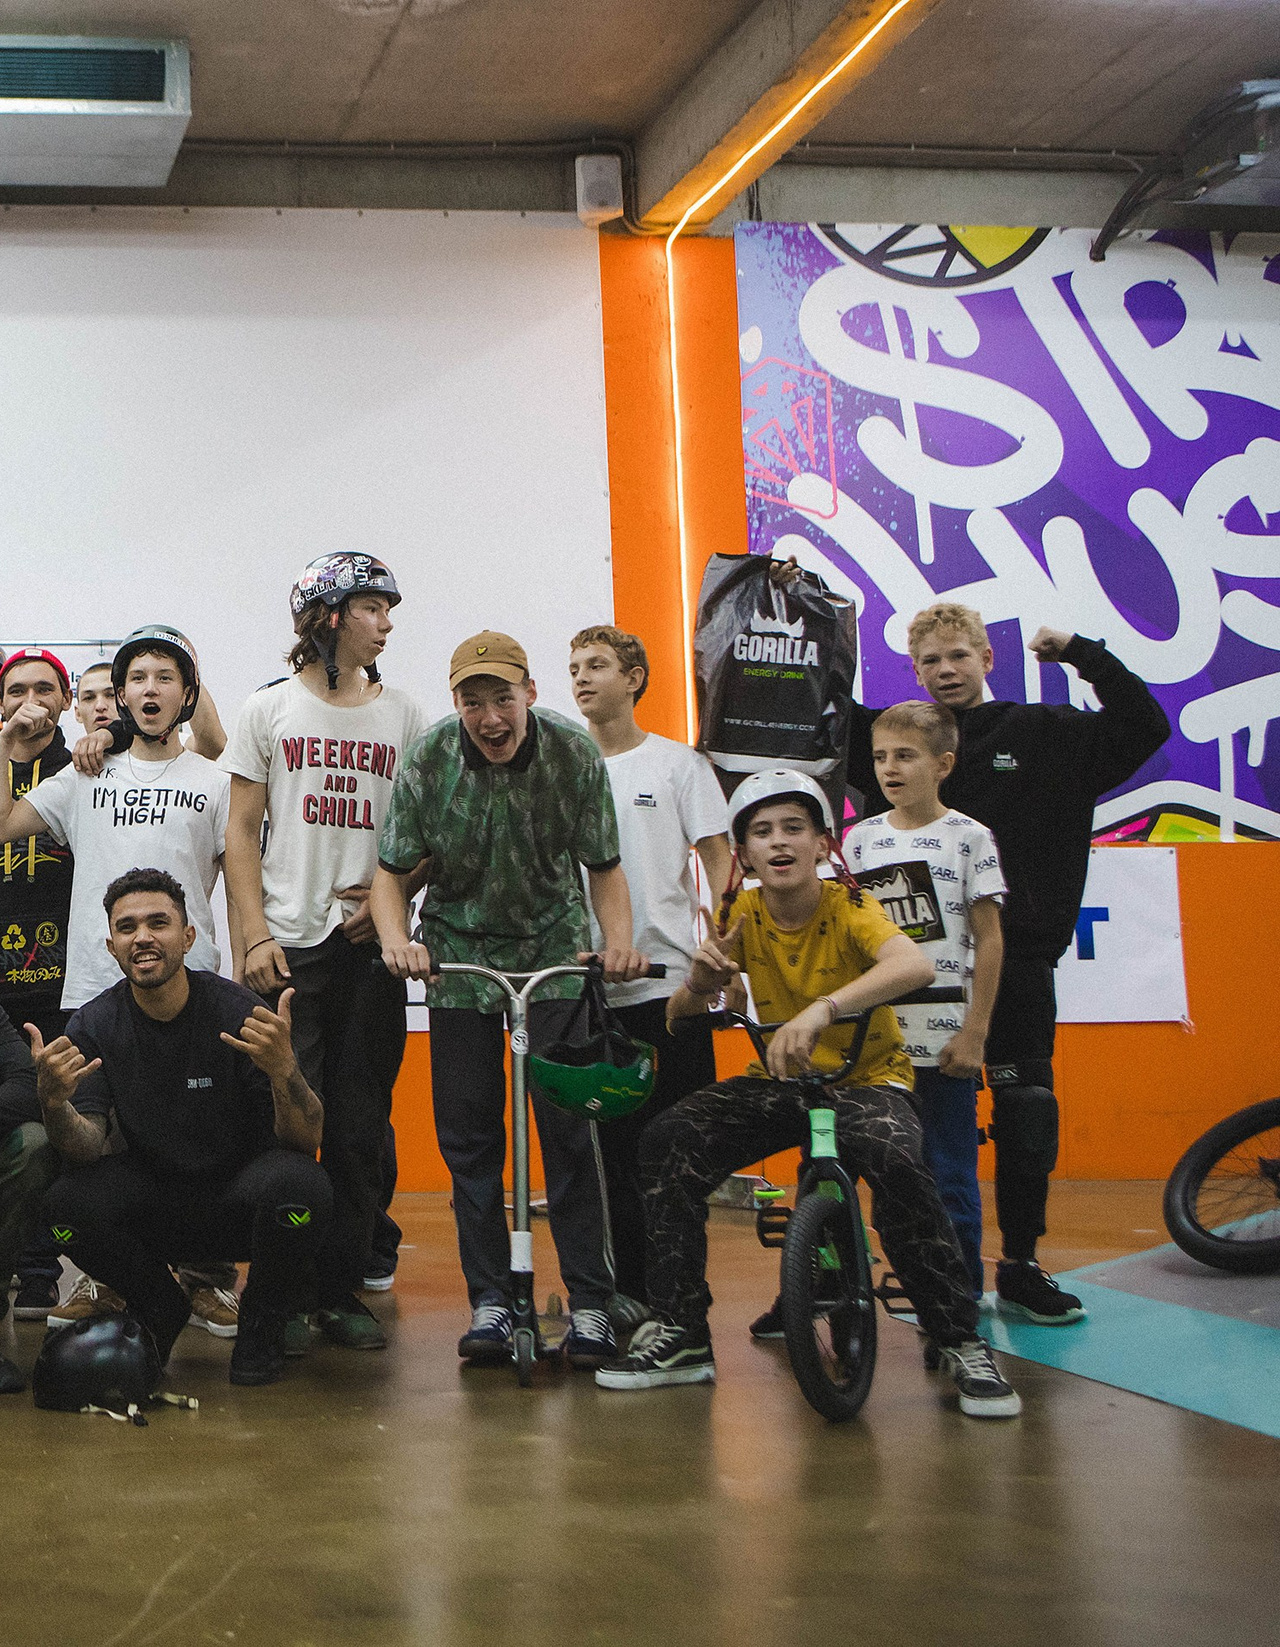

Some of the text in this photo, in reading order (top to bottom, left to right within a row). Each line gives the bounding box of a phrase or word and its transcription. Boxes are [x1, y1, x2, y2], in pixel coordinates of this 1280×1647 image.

[733, 634, 819, 666] GORILLA
[743, 668, 805, 680] ENERGY DRINK
[282, 737, 396, 781] WEEKEND
[324, 774, 357, 793] AND
[93, 787, 208, 812] I'M GETTING
[113, 807, 166, 827] HIGH
[303, 794, 375, 831] CHILL
[912, 838, 942, 849] KARL
[929, 866, 958, 880] KARL
[974, 856, 998, 873] KAR
[935, 959, 959, 970] KAR
[927, 1018, 961, 1028] KARL
